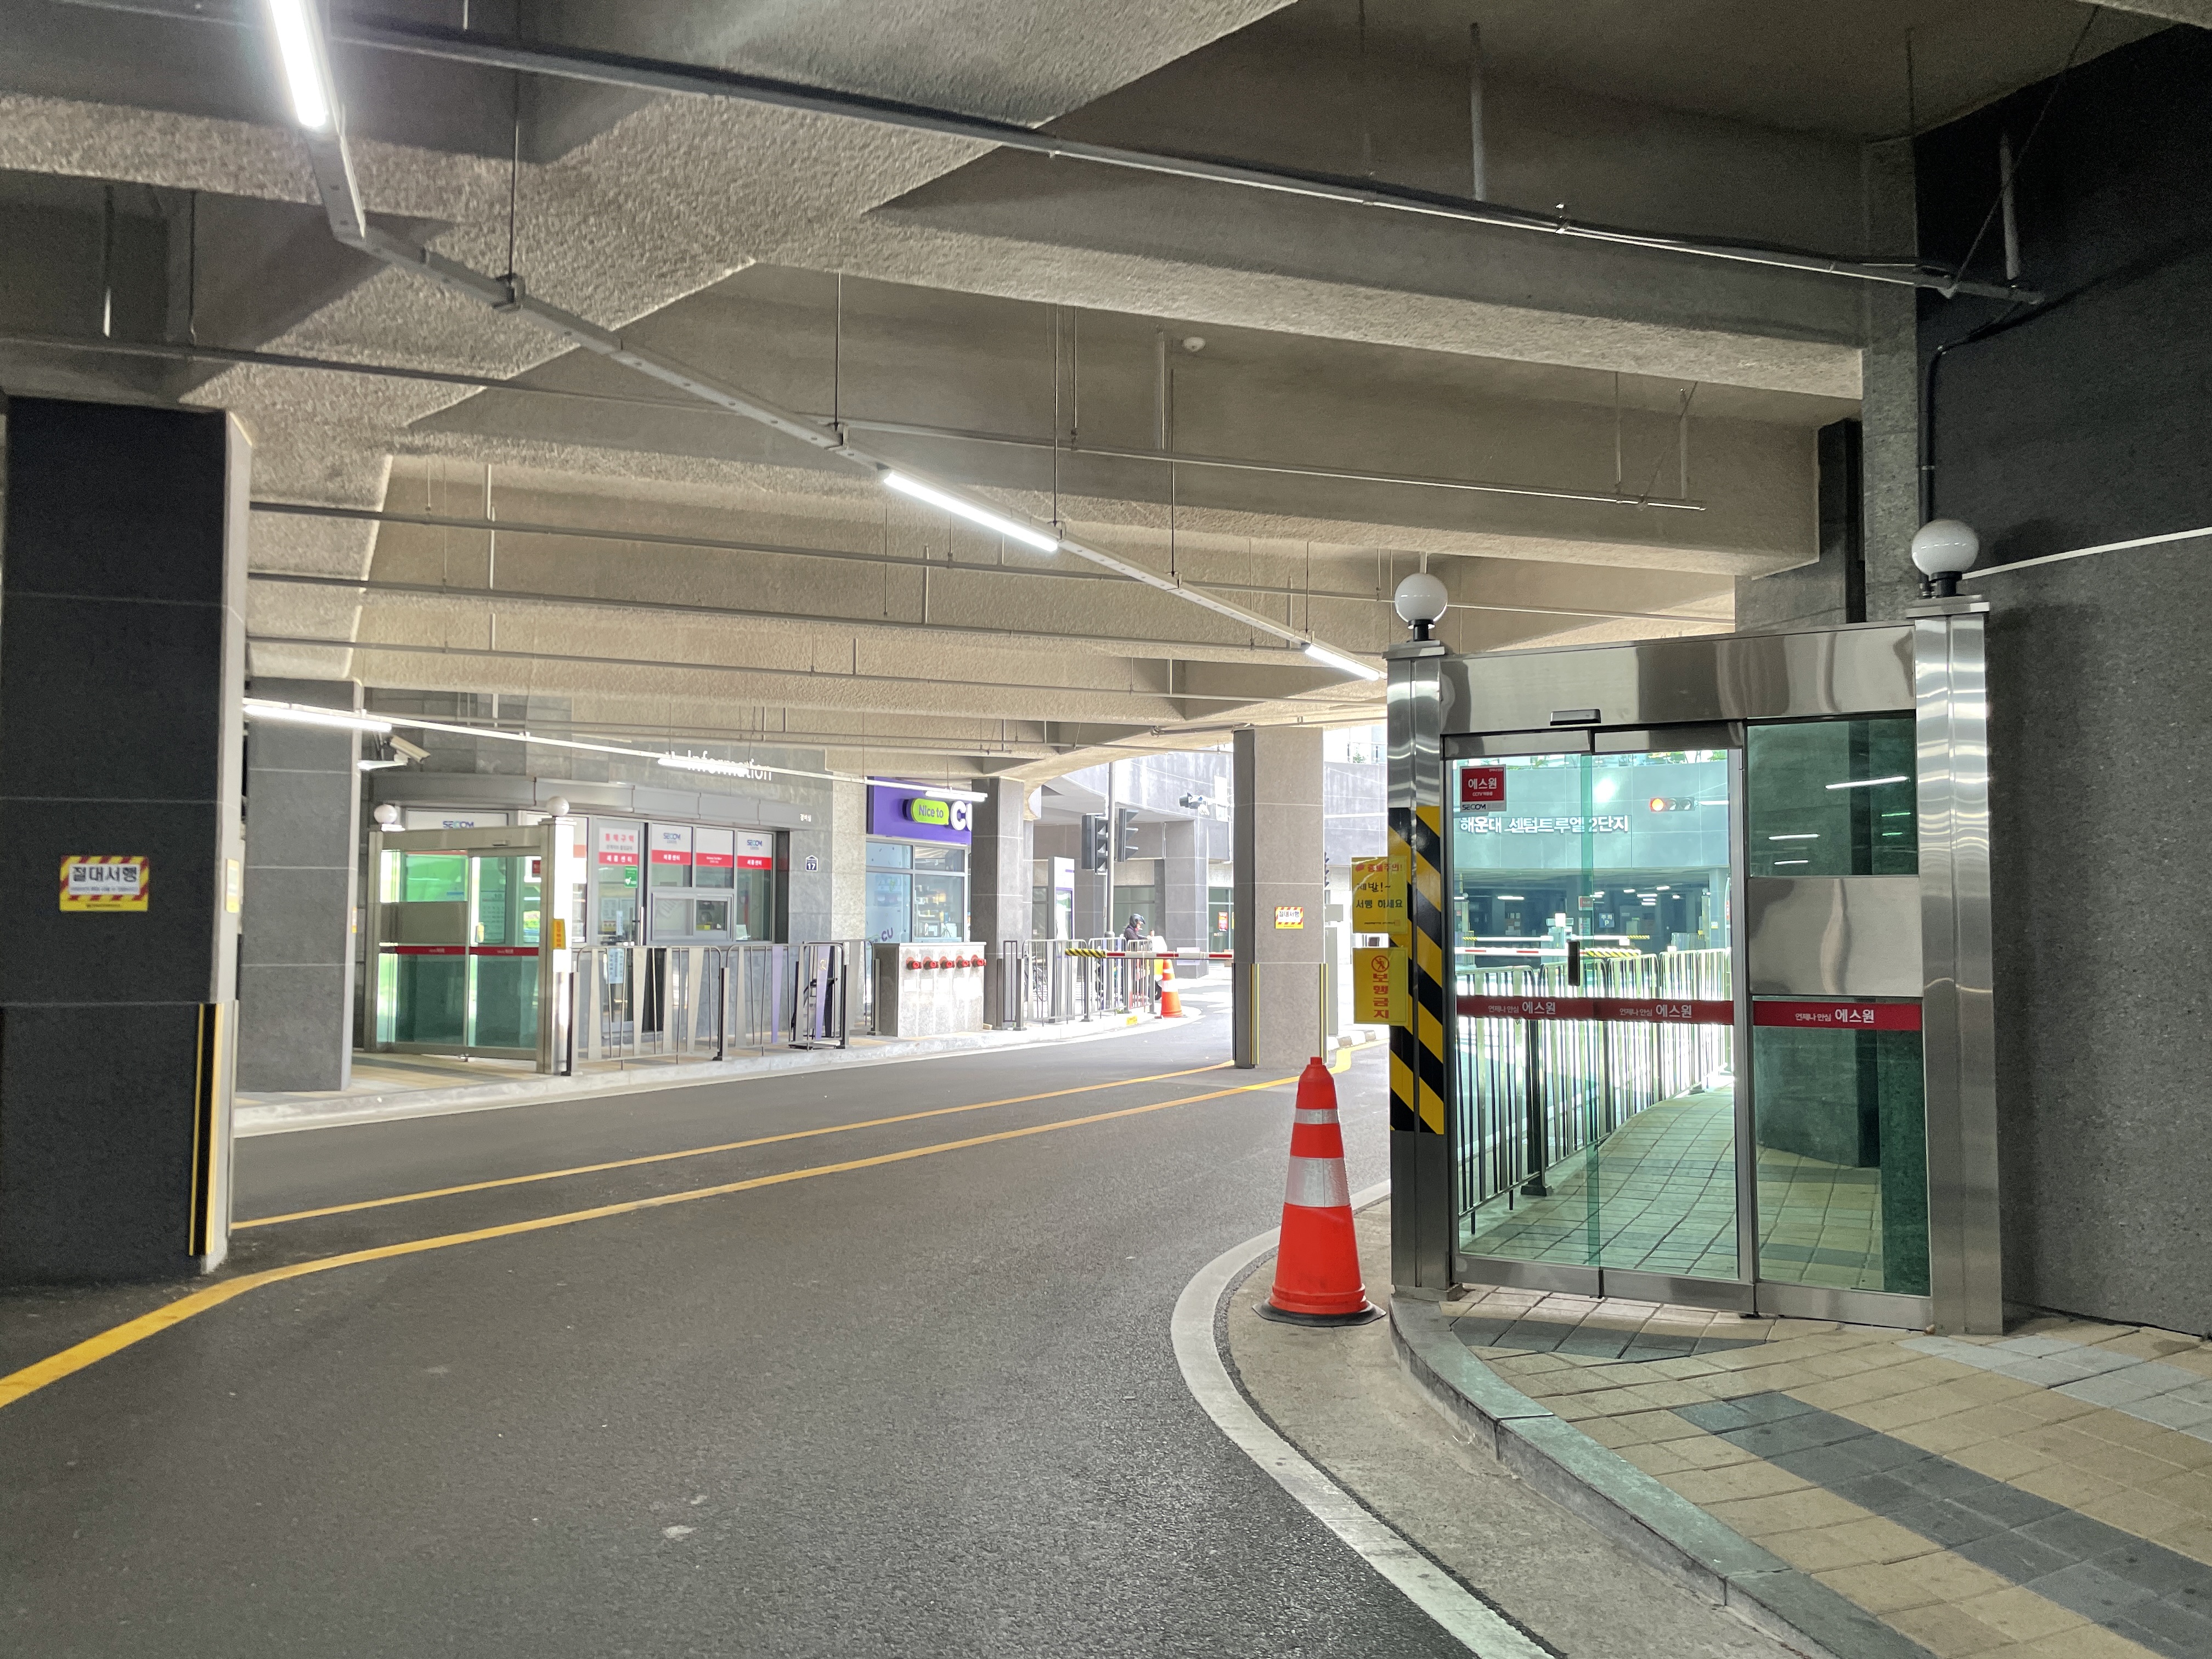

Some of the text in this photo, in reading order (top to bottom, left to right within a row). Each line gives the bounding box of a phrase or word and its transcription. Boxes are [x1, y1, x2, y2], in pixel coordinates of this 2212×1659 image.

[687, 749, 772, 781] Iftion
[1468, 777, 1497, 789] 에스원
[919, 804, 944, 818] Nice to
[1460, 815, 1628, 834] 해운대 센텀트루엘 2단지
[74, 866, 137, 883] 절대서행
[1356, 899, 1403, 909] 서행 하세요
[881, 927, 894, 942] CU
[1373, 973, 1389, 1019] 보행금지
[1522, 1001, 1556, 1015] 에스원
[1656, 1005, 1692, 1018] 에스원
[1835, 1009, 1875, 1024] 에스원
